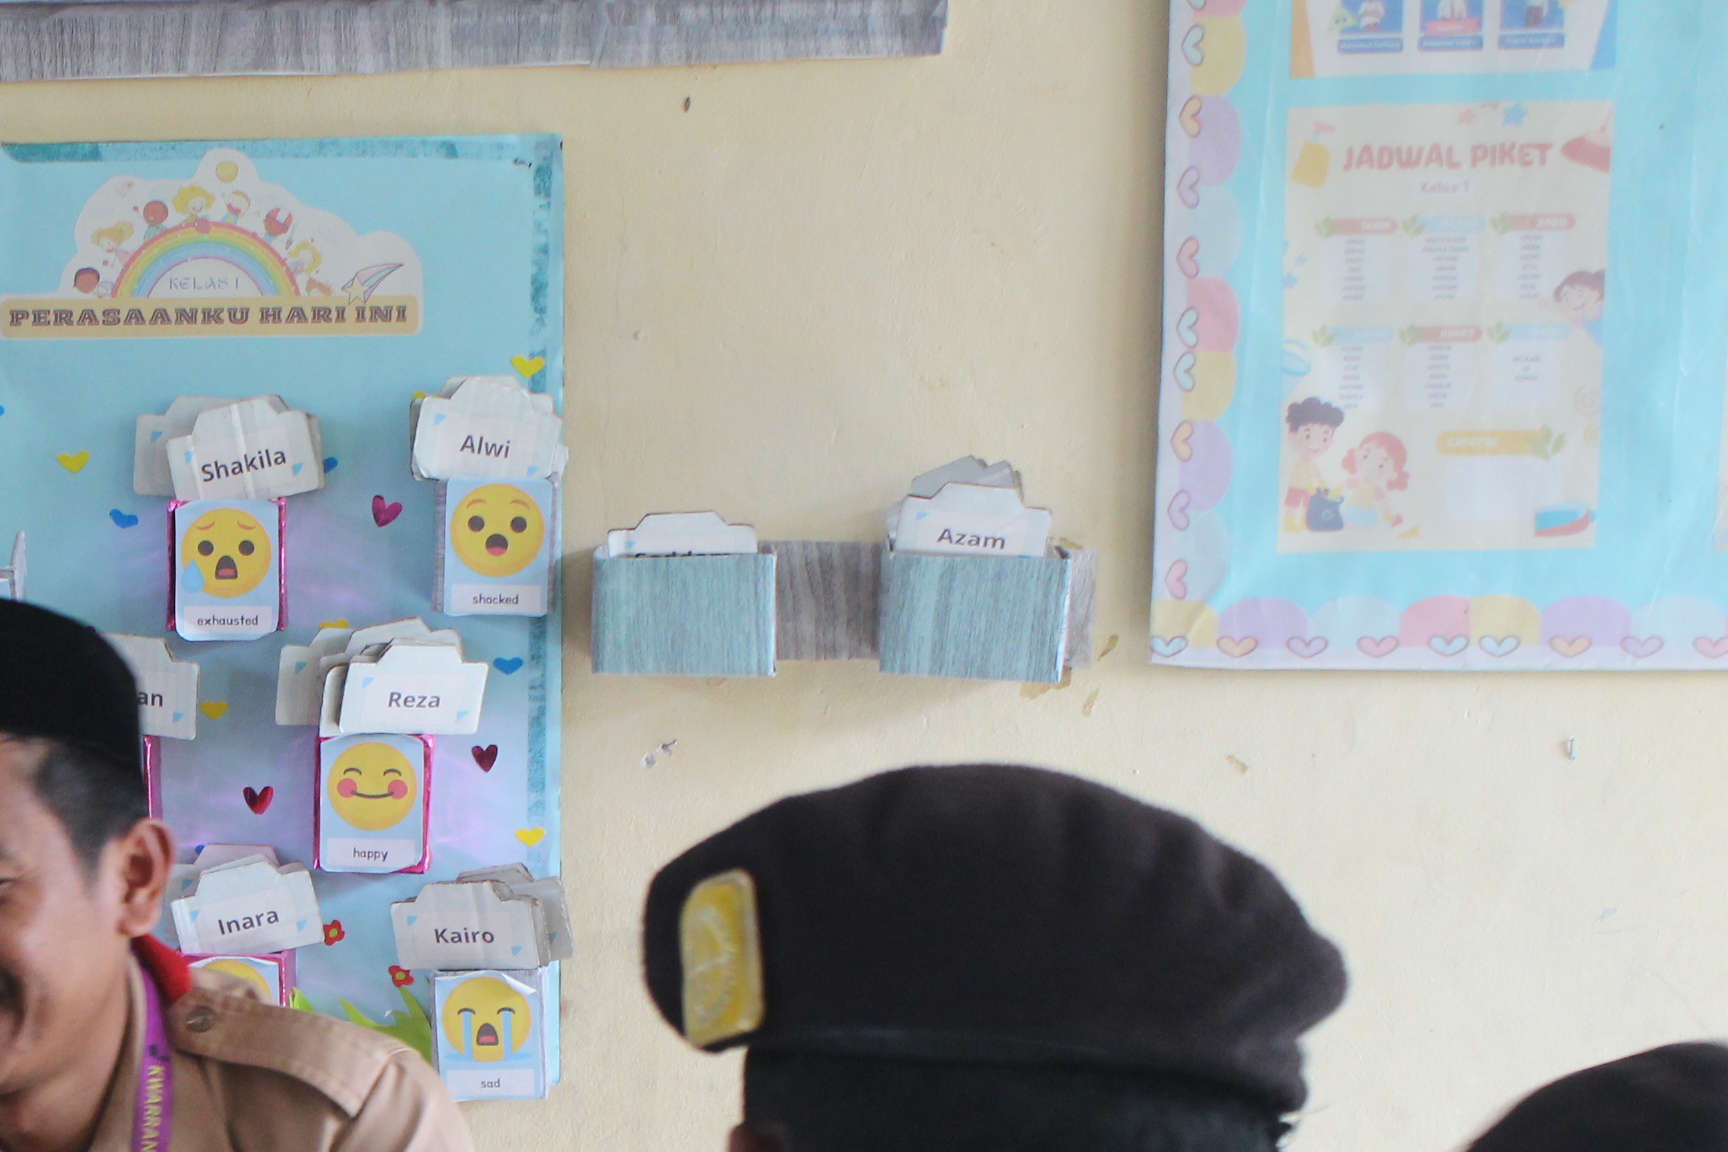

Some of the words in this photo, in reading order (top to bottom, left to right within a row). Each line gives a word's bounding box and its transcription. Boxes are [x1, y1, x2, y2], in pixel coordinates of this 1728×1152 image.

[1342, 142, 1461, 172] JADWAL
[1470, 140, 1554, 169] PIKET
[1419, 181, 1459, 195] Kelas
[1462, 179, 1470, 194] 1
[169, 276, 229, 290] KELAS
[9, 307, 251, 327] PERASAANKU
[259, 305, 346, 324] HARI
[355, 305, 407, 323] INI
[459, 433, 511, 459] Alwi
[200, 446, 288, 483] Shakila
[936, 527, 1006, 551] Azam
[472, 592, 519, 606] shocked
[196, 613, 259, 627] exhausted
[136, 691, 164, 707] an
[387, 690, 442, 711] Reza
[352, 847, 389, 864] happy
[217, 906, 280, 936] Inara
[433, 926, 495, 946] Kairo
[480, 1076, 502, 1090] sad
